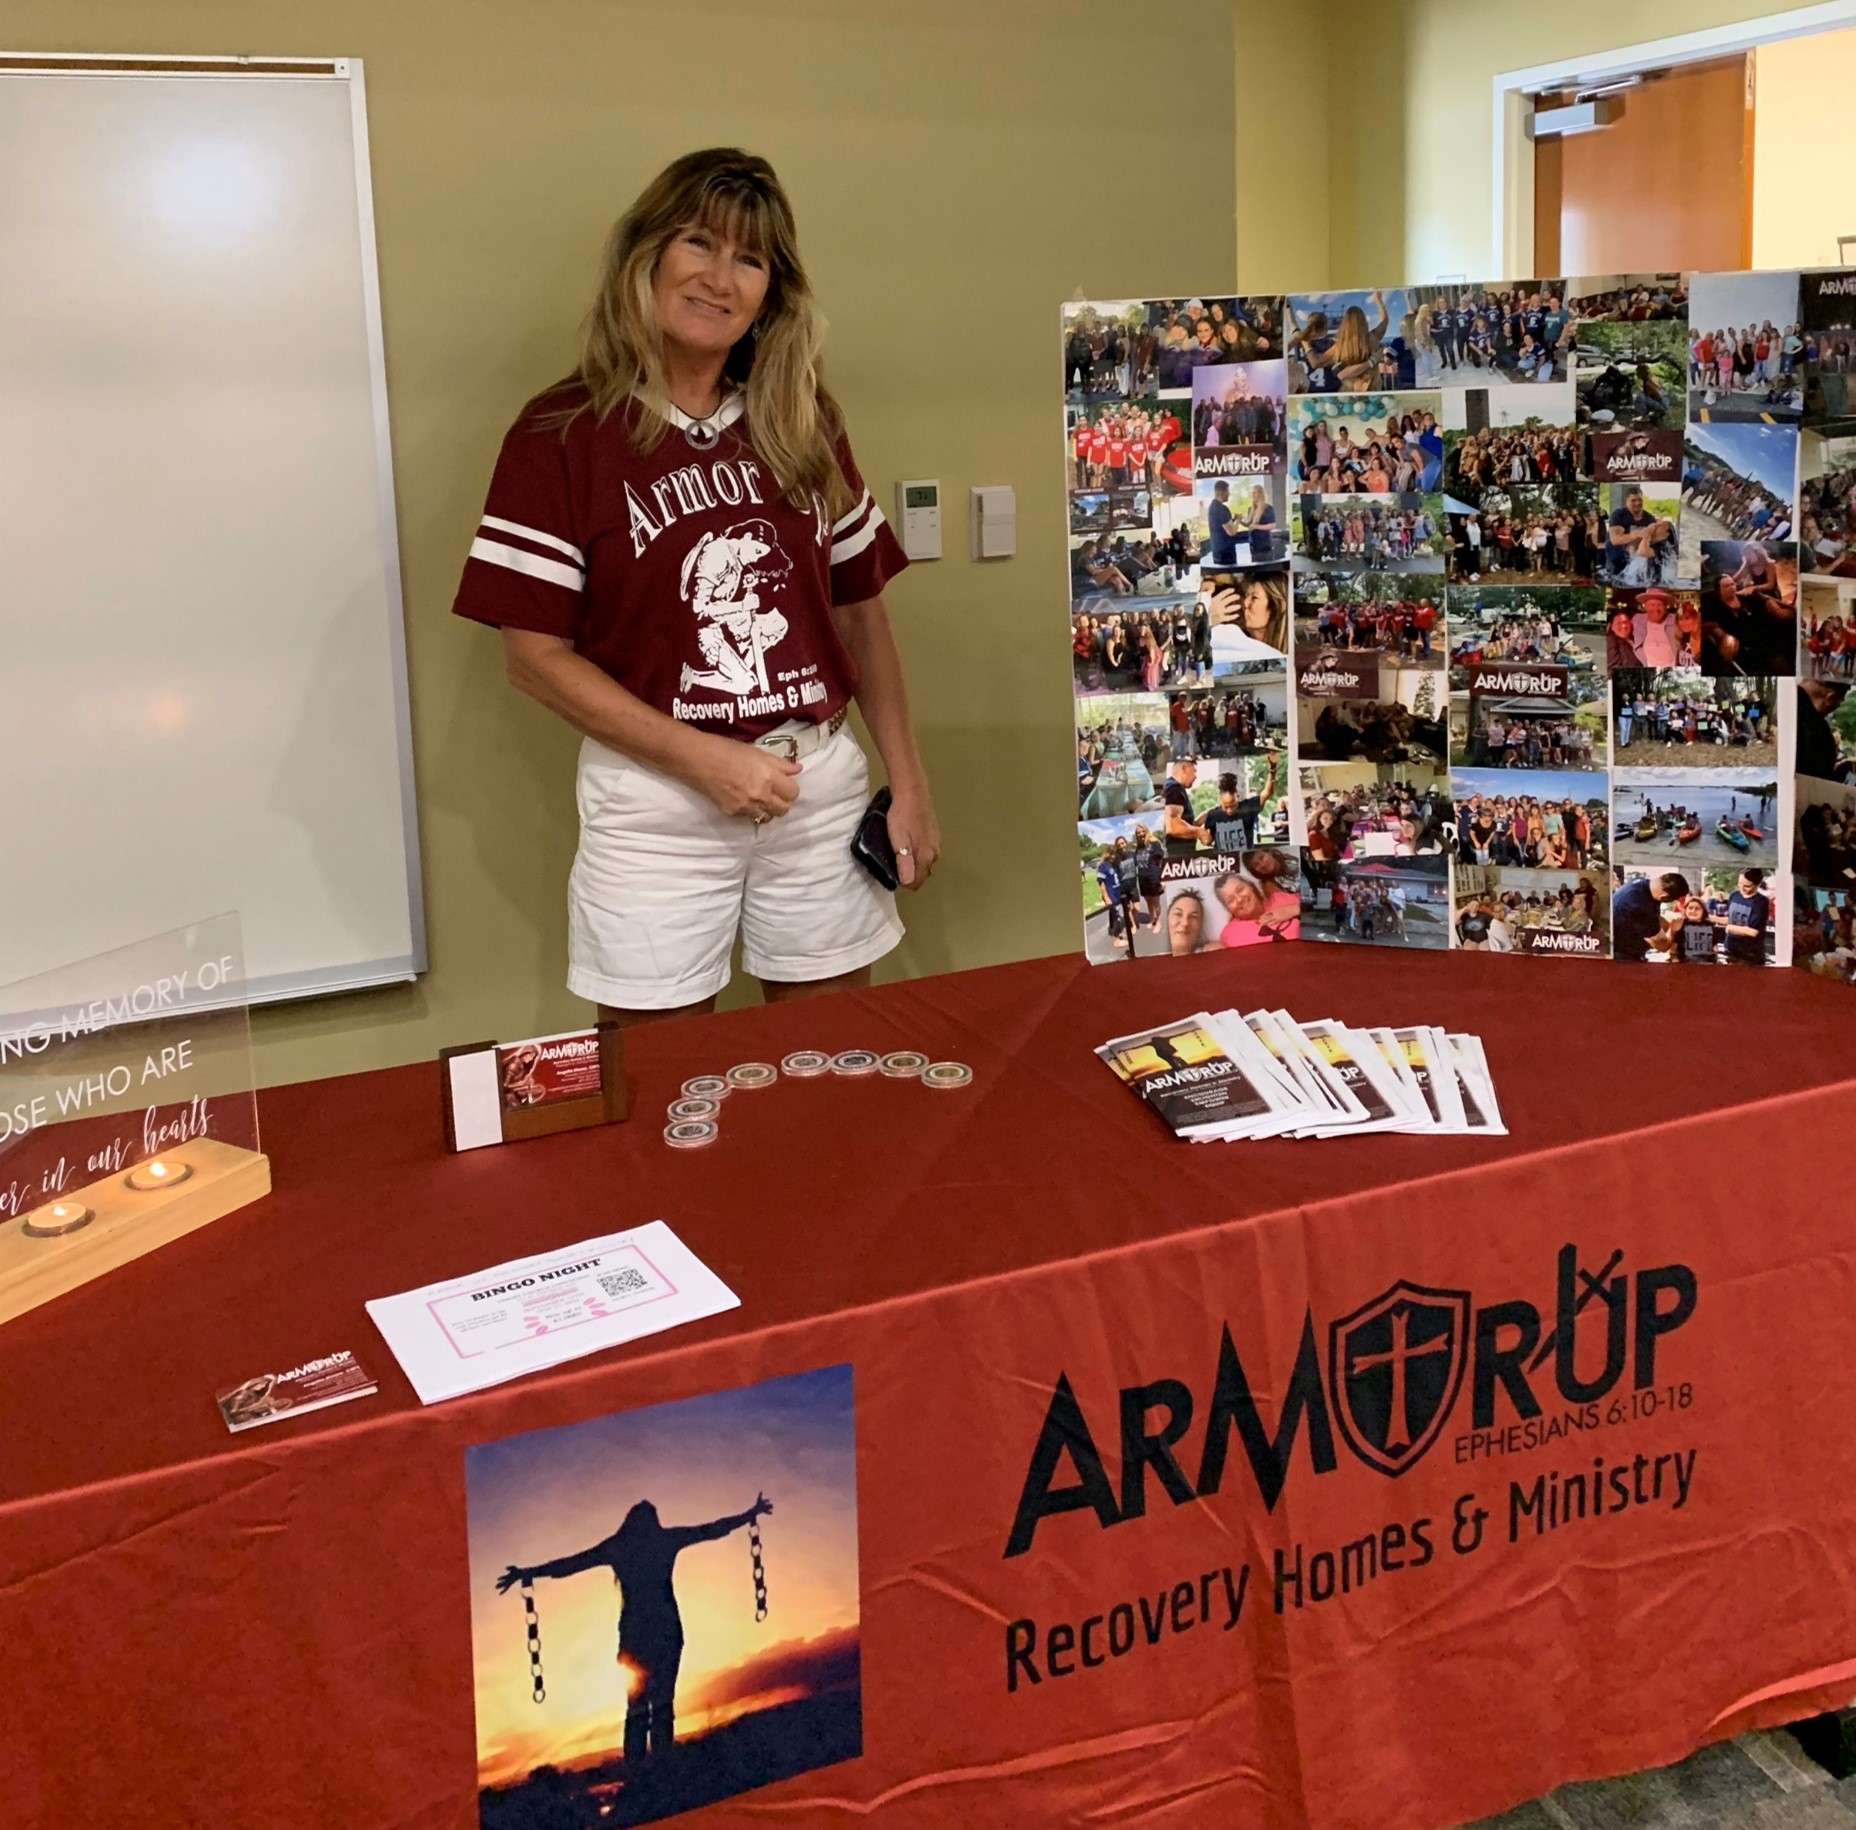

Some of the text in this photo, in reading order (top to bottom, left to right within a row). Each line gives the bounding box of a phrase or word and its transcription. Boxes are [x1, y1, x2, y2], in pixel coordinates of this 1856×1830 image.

[623, 461, 764, 559] Armor
[672, 697, 735, 724] Recovery
[737, 692, 785, 719] Homes
[786, 685, 799, 708] &
[777, 669, 799, 682] Eph
[61, 971, 189, 1044] MEMORY
[197, 955, 234, 991] OF
[55, 1064, 132, 1115] WHO
[141, 1039, 194, 1086] ARE
[42, 1156, 76, 1193] in
[87, 1137, 133, 1173] our
[143, 1093, 214, 1154] hearts
[470, 1278, 536, 1302] BINGO
[538, 1258, 602, 1283] NIGHT
[1454, 1382, 1693, 1464] EPHESIANS 6:10-18
[1006, 1449, 1697, 1693] Recovery Homes & Ministry
